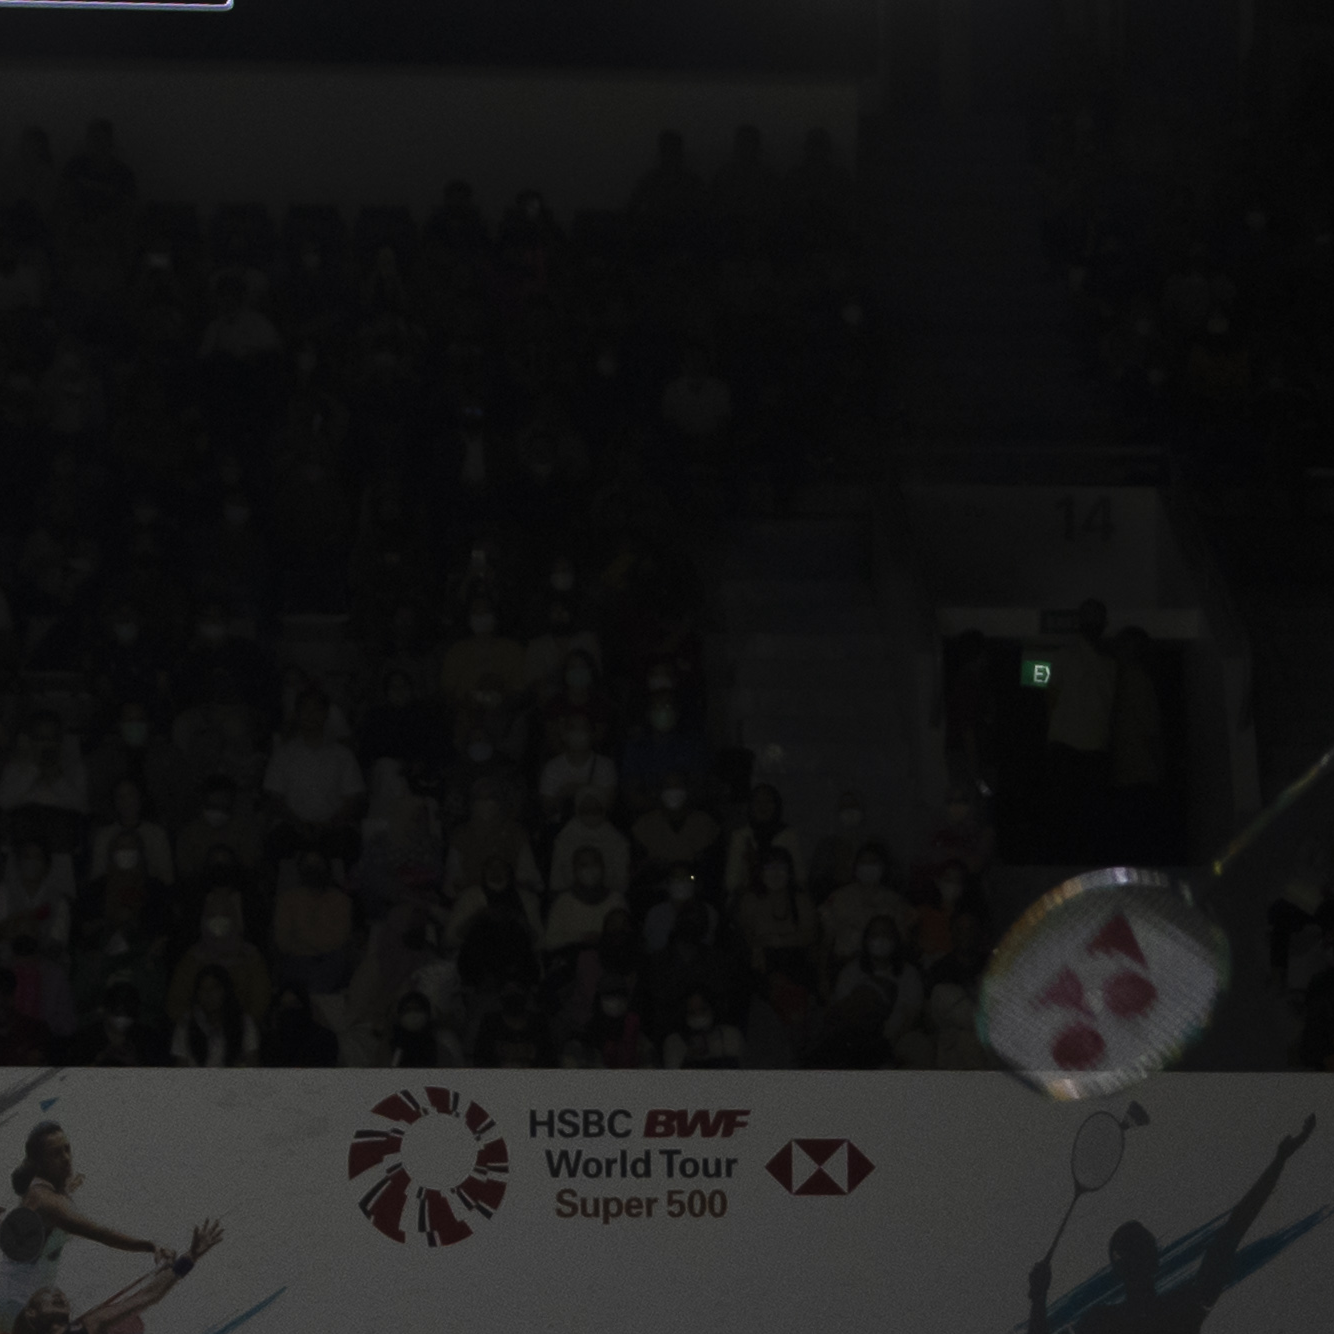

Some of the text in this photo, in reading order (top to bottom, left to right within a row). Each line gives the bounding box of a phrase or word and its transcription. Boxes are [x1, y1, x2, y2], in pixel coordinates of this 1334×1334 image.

[529, 1109, 751, 1138] HSBC BWF
[545, 1150, 738, 1178] World Tour
[555, 1188, 728, 1224] Super 500
